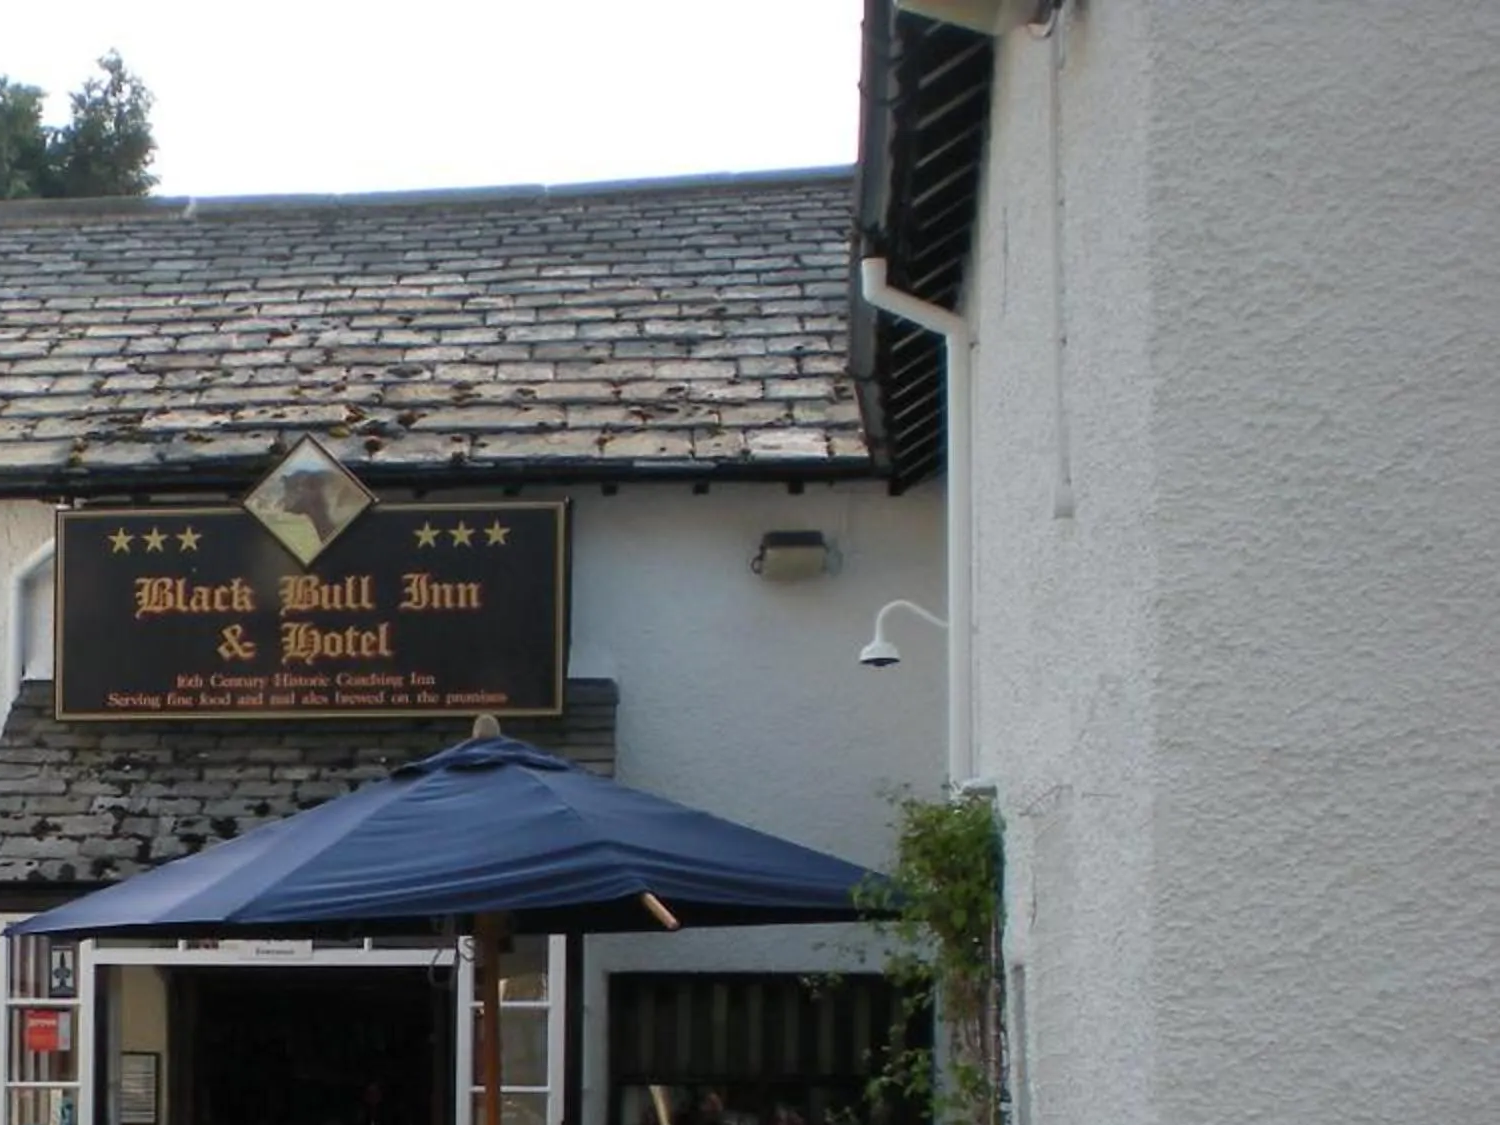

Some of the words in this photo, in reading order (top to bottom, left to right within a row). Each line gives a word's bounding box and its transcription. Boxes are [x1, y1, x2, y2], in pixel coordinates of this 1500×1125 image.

[134, 576, 254, 618] Black
[279, 574, 374, 614] Bull
[400, 572, 482, 611] Inn
[217, 624, 256, 660] &
[280, 622, 392, 664] Hotel
[210, 674, 266, 689] Century
[335, 673, 403, 688] Coaching
[409, 672, 435, 685] Inn
[108, 693, 160, 708] Serving
[167, 693, 193, 706] fine
[198, 692, 231, 706] food
[237, 692, 264, 706] and
[334, 691, 386, 705] brewed
[391, 694, 411, 705] on
[417, 691, 441, 704] the
